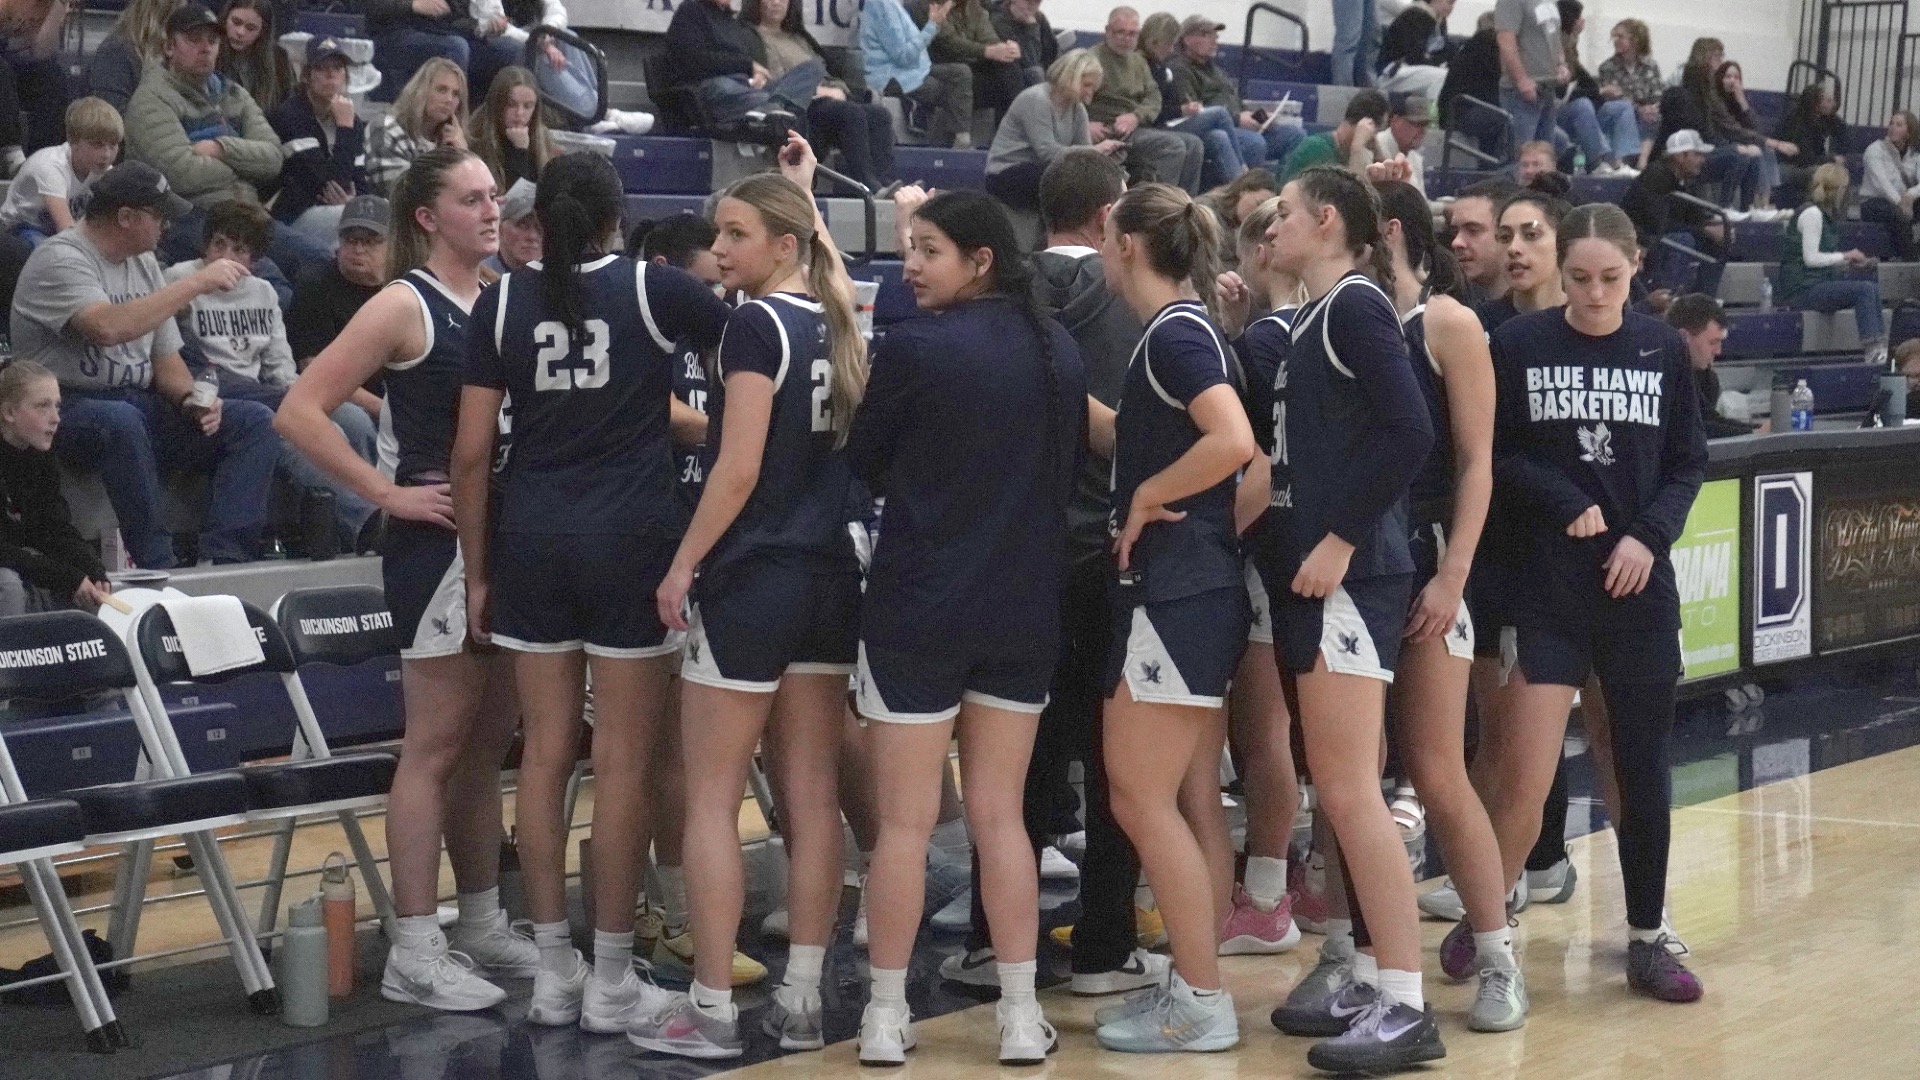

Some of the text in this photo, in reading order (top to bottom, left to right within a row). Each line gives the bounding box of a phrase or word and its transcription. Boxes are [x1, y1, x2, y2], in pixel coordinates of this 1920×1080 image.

[198, 308, 274, 338] BLUE HAWKS
[79, 340, 150, 387] STAT
[533, 319, 610, 392] 23
[684, 351, 706, 381] Blu
[1526, 366, 1663, 397] BLUE HAWK
[1528, 389, 1661, 427] BASKETBALL
[299, 616, 359, 636] DICKINSON
[1683, 605, 1716, 629] TO
[1753, 628, 1808, 649] DICKINSON
[0, 639, 107, 669] DICKINSON STATE
